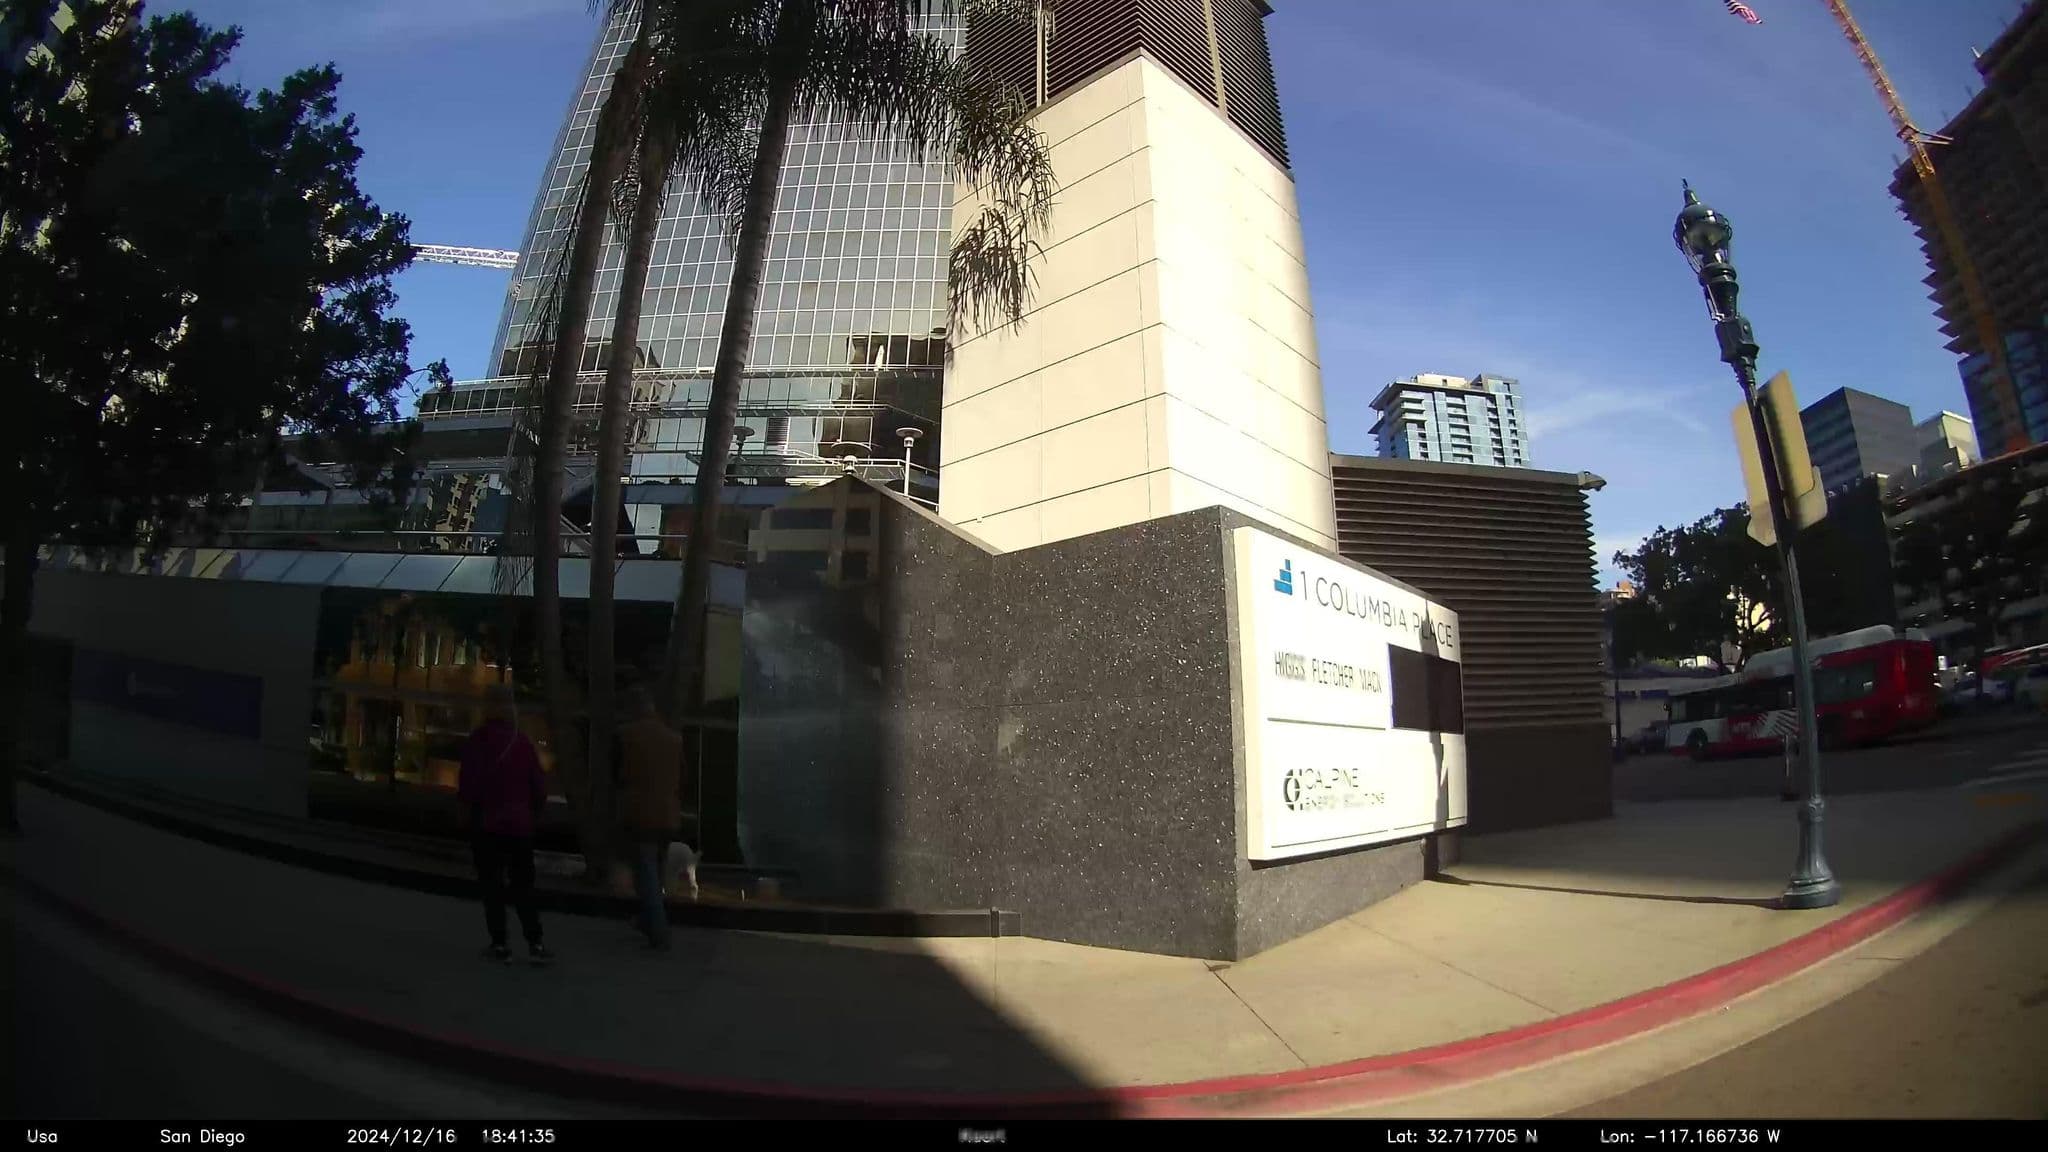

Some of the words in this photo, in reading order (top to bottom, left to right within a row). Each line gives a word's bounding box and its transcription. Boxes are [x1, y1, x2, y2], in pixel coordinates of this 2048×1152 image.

[1300, 570, 1308, 601] 1
[1315, 577, 1408, 633] COLUMBIA
[1413, 612, 1454, 649] PLACE
[1312, 658, 1354, 688] FLETCHER
